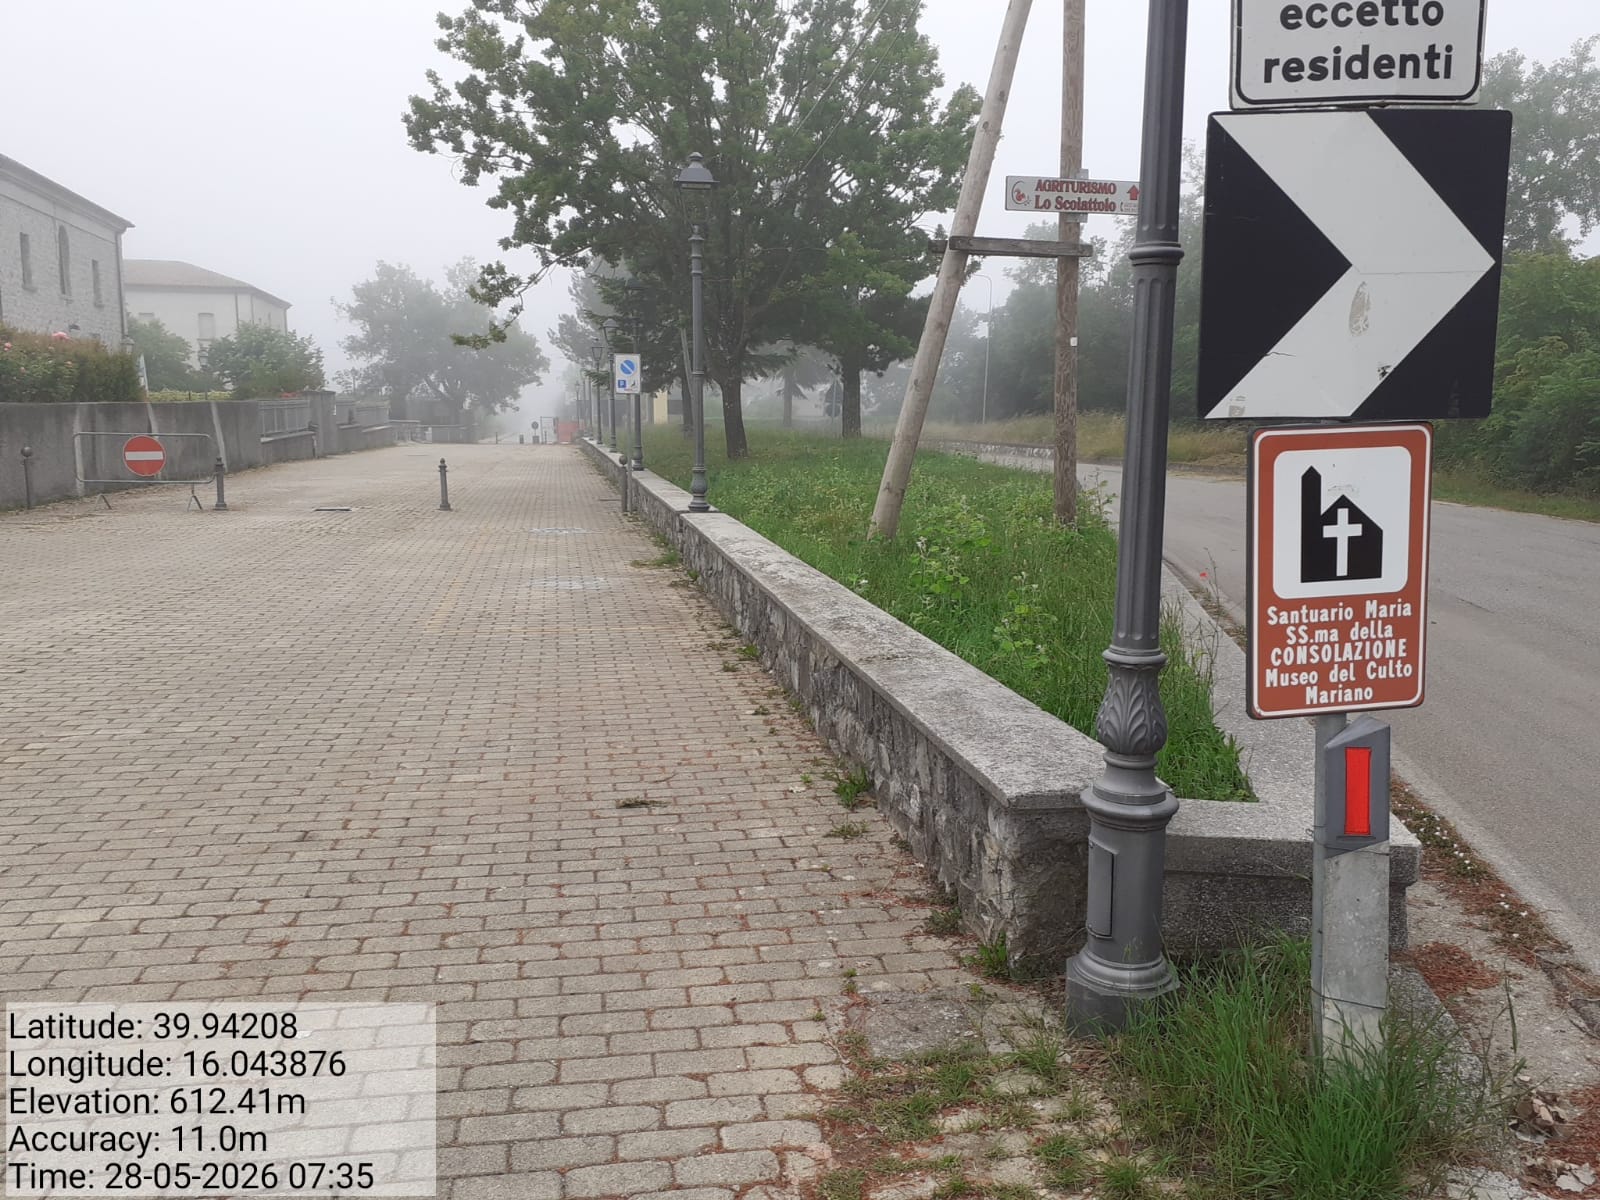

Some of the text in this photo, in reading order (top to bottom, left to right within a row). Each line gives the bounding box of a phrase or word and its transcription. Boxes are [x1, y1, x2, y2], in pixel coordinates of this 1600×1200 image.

[1279, 0, 1444, 30] eccetto
[1263, 43, 1454, 83] residenti
[1035, 179, 1117, 194] AGRITURISMO
[1034, 195, 1051, 210] Lo
[1267, 598, 1412, 625] Santuario Maria
[1286, 620, 1393, 645] SS.ma della
[1270, 638, 1407, 667] CONSOLAZIONE
[1265, 659, 1413, 688] Museo del Culto
[1305, 684, 1373, 705] Mariano
